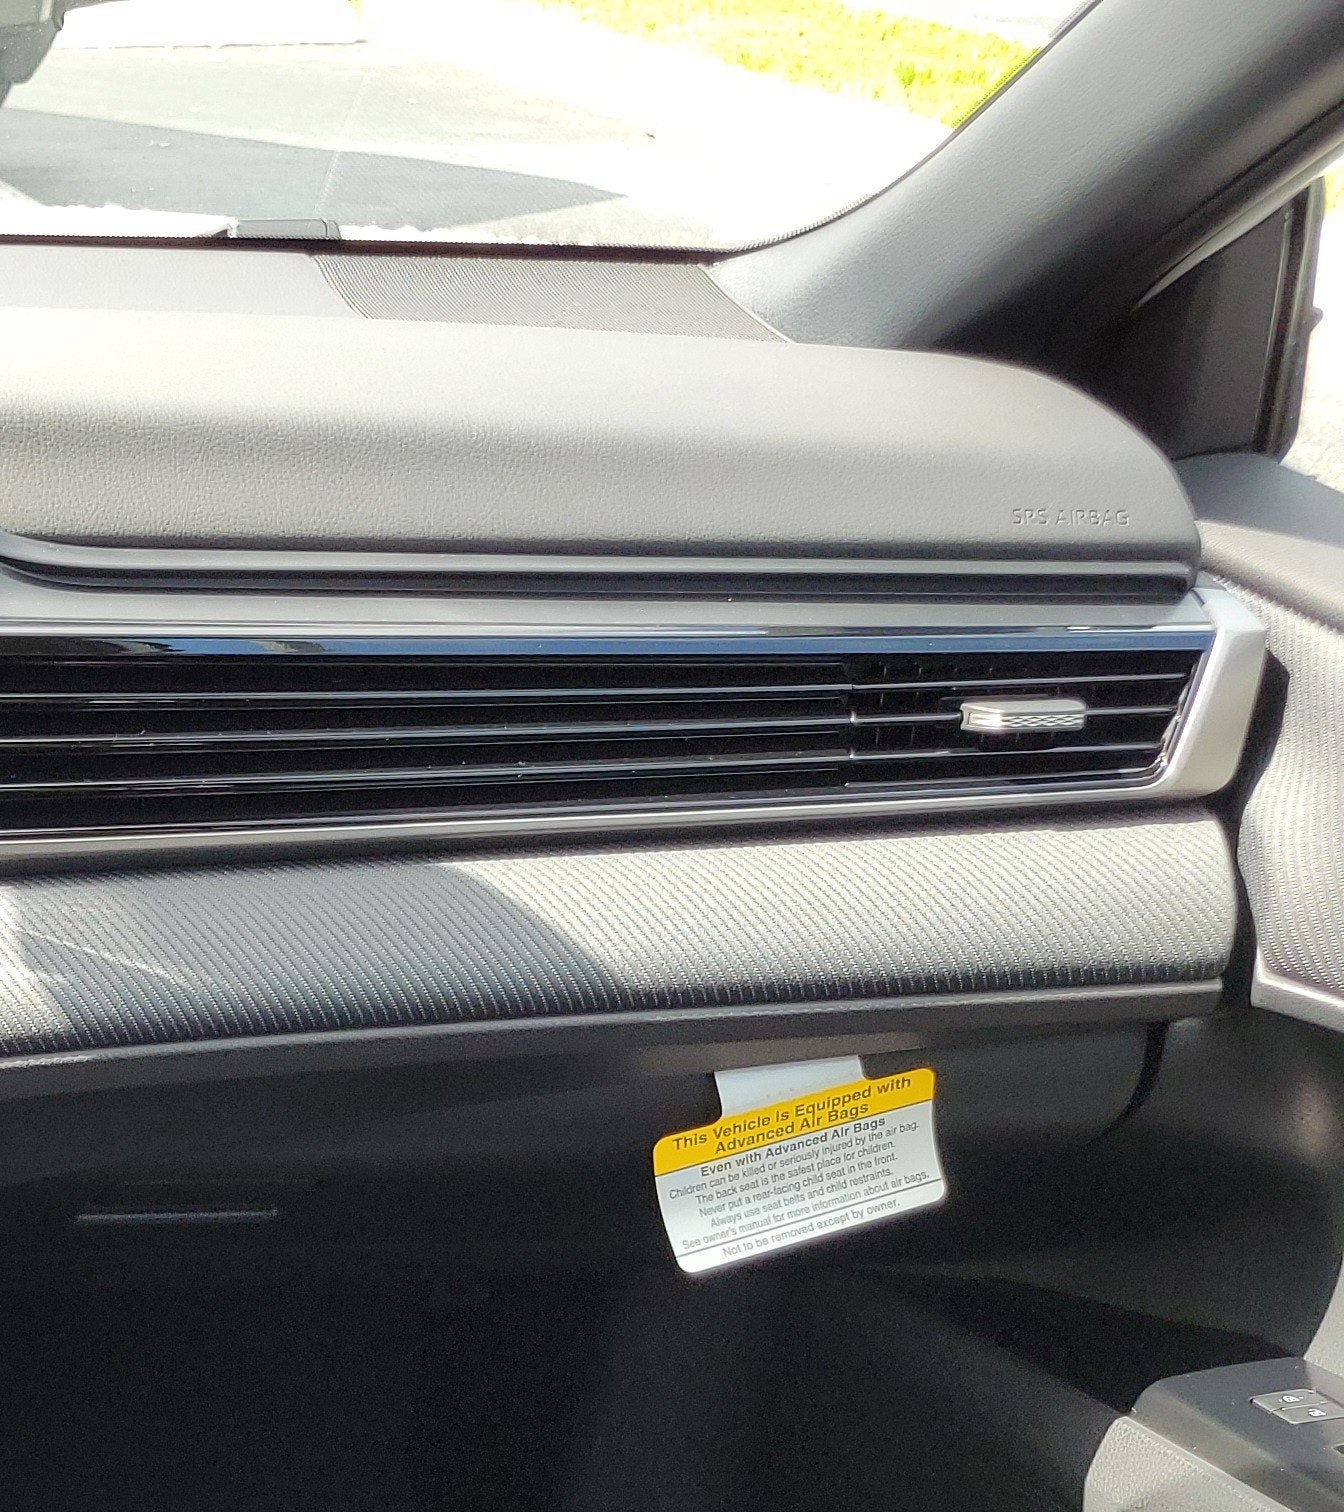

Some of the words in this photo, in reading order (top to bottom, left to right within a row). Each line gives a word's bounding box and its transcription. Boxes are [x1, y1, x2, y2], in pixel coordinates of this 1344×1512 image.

[672, 1133, 708, 1150] This
[713, 1115, 770, 1139] Vehicle
[795, 1085, 871, 1118] Equipped
[877, 1077, 911, 1095] with
[714, 1122, 794, 1154] Advanced
[800, 1114, 823, 1131] Air
[828, 1103, 869, 1122] Bags
[669, 1182, 708, 1199] Children
[709, 1177, 726, 1187] can
[728, 1172, 740, 1182] be
[742, 1165, 765, 1179] killed
[767, 1162, 778, 1171] or
[780, 1148, 820, 1168] seriously
[822, 1138, 853, 1155] injured
[855, 1136, 866, 1147] by
[868, 1131, 883, 1142] the
[885, 1126, 898, 1137] air
[899, 1121, 919, 1133] bag.
[695, 1193, 713, 1204] The
[716, 1187, 737, 1199] back
[739, 1181, 759, 1192] seat
[771, 1172, 785, 1183] the
[788, 1164, 815, 1179] safest
[817, 1157, 841, 1172] place
[843, 1150, 855, 1161] for
[857, 1141, 896, 1158] children.
[701, 1161, 732, 1176] Even
[736, 1152, 762, 1167] with
[765, 1133, 828, 1159] Advanced
[831, 1126, 850, 1139] Air
[853, 1117, 886, 1134] Bags
[682, 1239, 701, 1250] See
[703, 1228, 737, 1244] owner's
[739, 1217, 772, 1233] manual
[772, 1212, 785, 1223] for
[787, 1206, 811, 1218] more
[812, 1190, 862, 1211] information
[864, 1183, 889, 1197] about
[891, 1178, 902, 1188] air
[904, 1170, 930, 1185] bags.
[699, 1204, 725, 1217] Never
[728, 1197, 742, 1210] put
[753, 1181, 801, 1202] rear-facing
[802, 1174, 824, 1187] child
[825, 1169, 845, 1180] seat
[858, 1159, 872, 1170] the
[874, 1153, 898, 1166] front.
[711, 1212, 742, 1228] Always
[744, 1206, 761, 1217] use
[762, 1200, 782, 1212] seat
[784, 1193, 806, 1206] belts
[808, 1186, 825, 1198] and
[826, 1180, 847, 1193] child
[849, 1168, 893, 1187] restraints.
[722, 1246, 741, 1257] Not
[743, 1242, 753, 1251] to
[756, 1237, 769, 1248] be
[772, 1222, 815, 1244] removed
[817, 1212, 851, 1229] except
[852, 1208, 864, 1220] by
[867, 1199, 901, 1215] owner.
